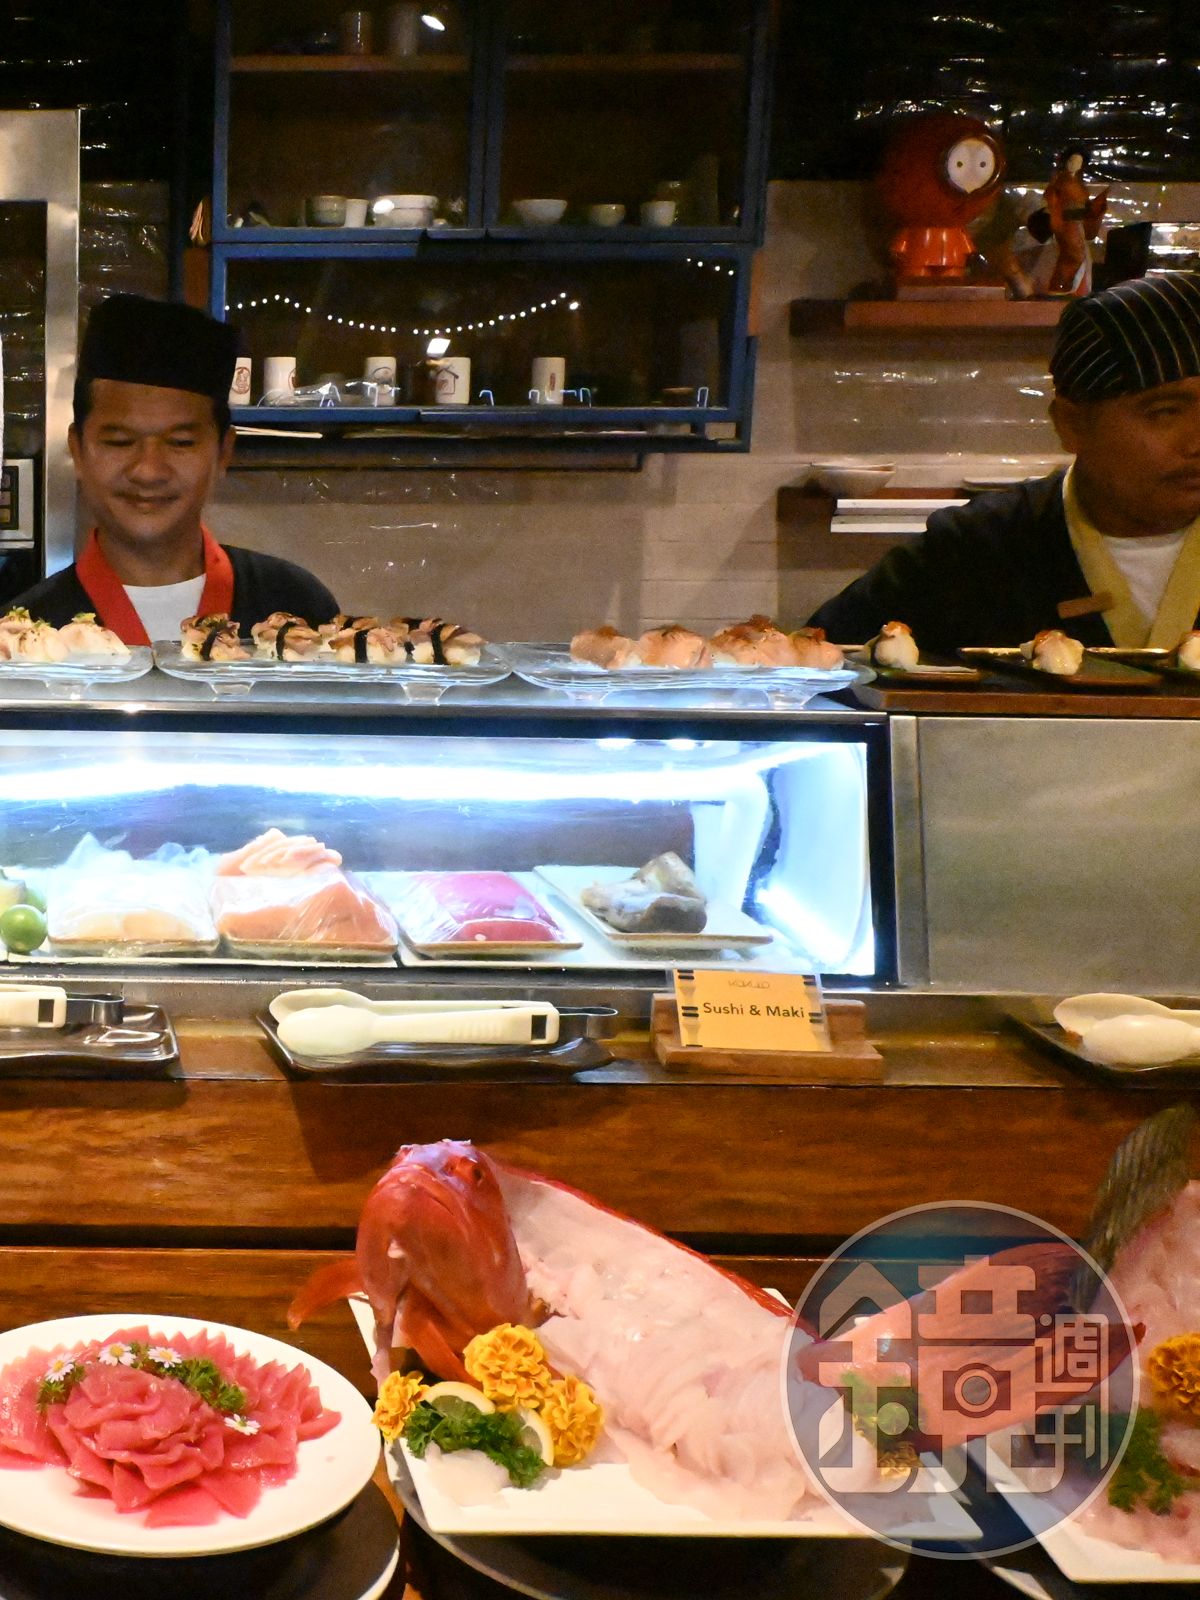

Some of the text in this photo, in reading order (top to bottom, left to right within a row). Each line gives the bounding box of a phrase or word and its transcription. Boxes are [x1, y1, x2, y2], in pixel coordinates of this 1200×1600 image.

[703, 1002, 804, 1018] Sushi & Maki
